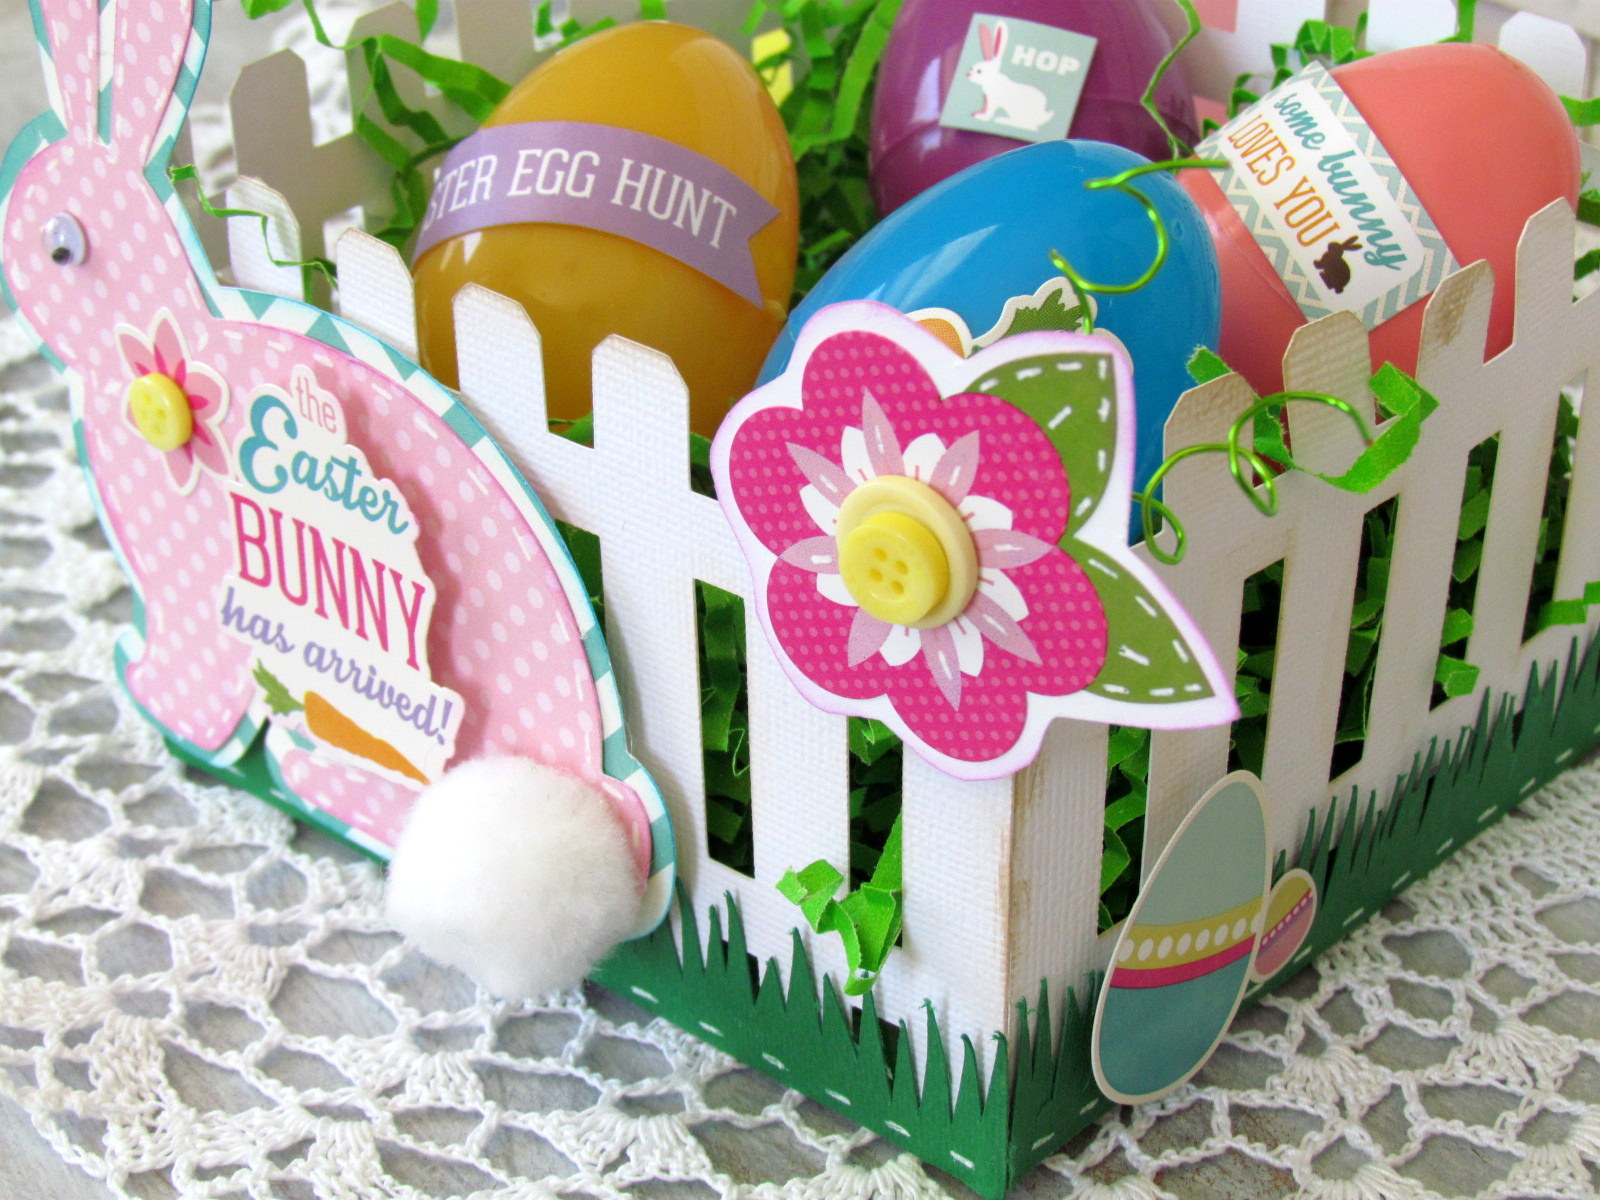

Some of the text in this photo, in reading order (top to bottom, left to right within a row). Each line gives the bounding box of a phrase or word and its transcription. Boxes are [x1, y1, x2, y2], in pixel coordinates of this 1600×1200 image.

[1011, 44, 1081, 76] HOP
[507, 148, 600, 198] EGG
[610, 158, 738, 249] HUNT
[1227, 114, 1340, 247] LOVES YOU
[1273, 92, 1408, 271] some bunny
[238, 394, 409, 535] Easter
[296, 376, 336, 434] the
[229, 491, 426, 672] BUNNY
[220, 586, 454, 746] has arrived!
